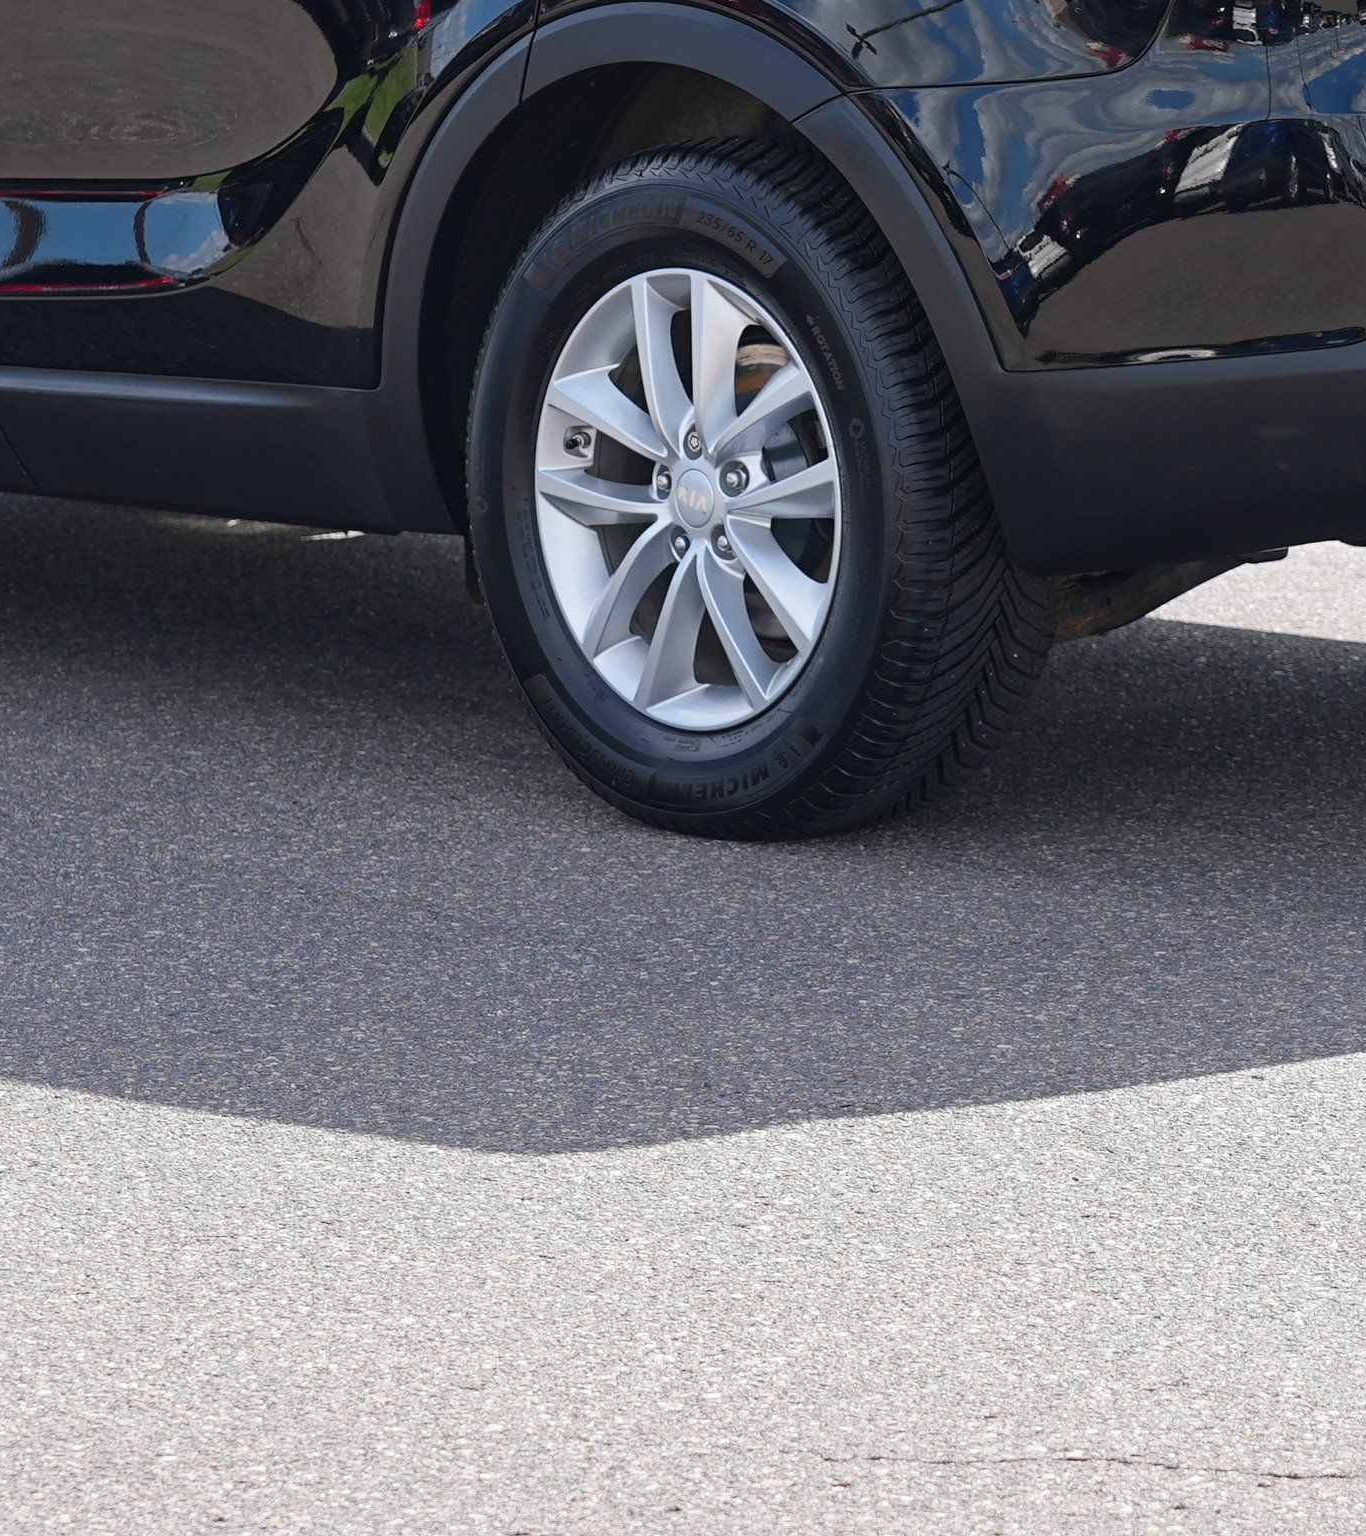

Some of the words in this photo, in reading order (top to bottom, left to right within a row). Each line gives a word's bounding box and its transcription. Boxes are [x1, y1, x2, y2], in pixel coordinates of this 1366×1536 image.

[696, 211, 744, 243] 235/65
[746, 239, 757, 253] R
[758, 250, 775, 265] 17
[655, 764, 770, 802] MICHE
